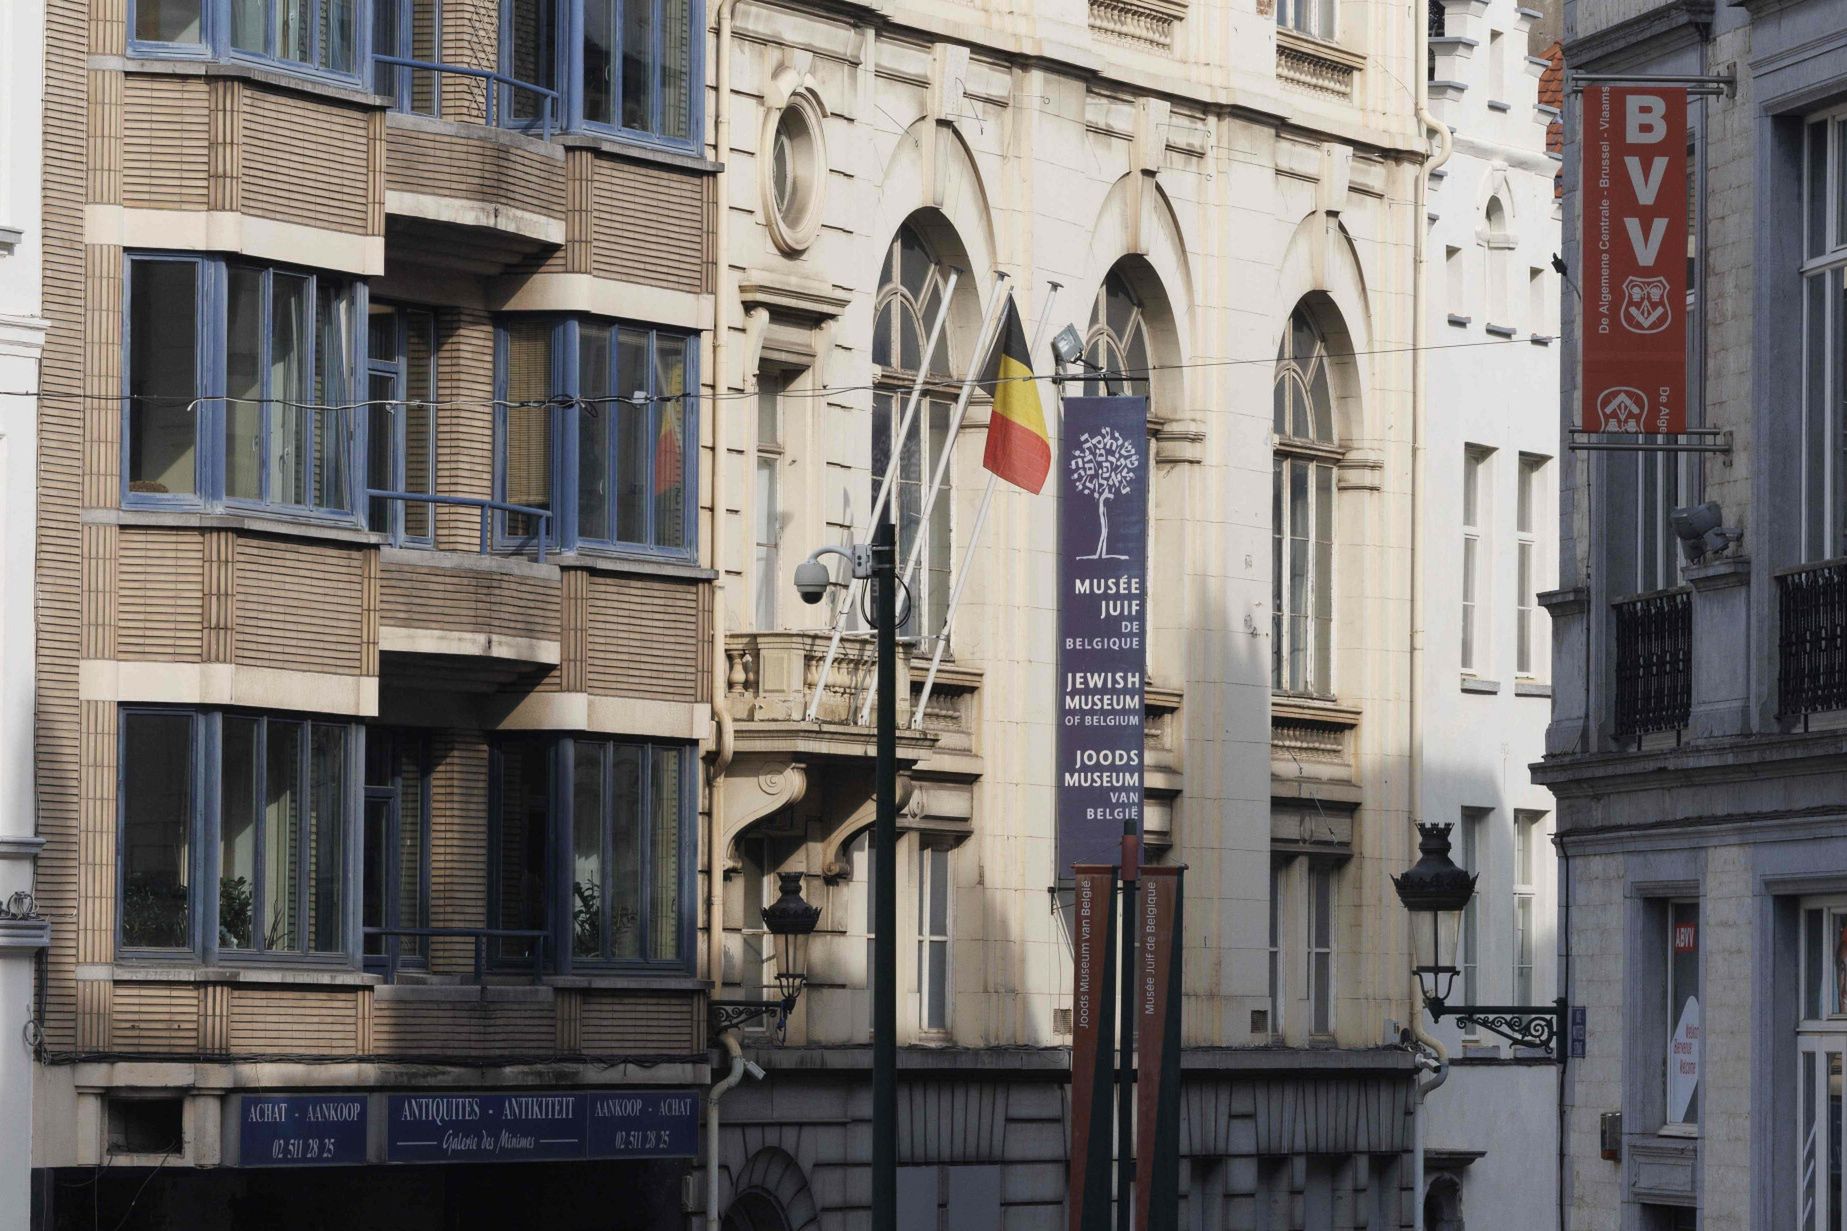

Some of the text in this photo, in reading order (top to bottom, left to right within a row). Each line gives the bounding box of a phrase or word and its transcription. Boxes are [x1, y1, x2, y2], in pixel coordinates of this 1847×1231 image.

[1600, 87, 1609, 130] Vlaams
[1600, 142, 1609, 187] Brussel
[1600, 199, 1609, 249] Centrale
[1600, 254, 1612, 314] Algemene
[1600, 319, 1609, 333] De
[1659, 387, 1669, 403] De
[1075, 575, 1139, 594] MUSÉE
[1101, 601, 1139, 619] JUIF
[1121, 622, 1139, 632] DE
[1066, 638, 1139, 650] BELGIQUE
[1067, 673, 1139, 690] JEWISH
[1065, 695, 1139, 709] MUSEUM
[1065, 716, 1139, 726] OF BELGIUM
[1076, 750, 1139, 767] JOODS
[1065, 772, 1139, 787] MUSEUM
[1110, 792, 1139, 803] VAN
[1087, 805, 1138, 819] BELGIË
[1676, 928, 1694, 947] ABVV
[1079, 880, 1091, 1028] Joods Museum van België
[1145, 882, 1157, 1015] Musée Juif de Belgique
[249, 1103, 287, 1122] ACHAT
[306, 1103, 360, 1122] AANKOOP
[402, 1099, 479, 1126] ANTIQUITES
[502, 1097, 575, 1120] ANTIKITEIT
[595, 1100, 643, 1118] AANKOOP
[659, 1099, 691, 1116] ACHAT
[273, 1138, 335, 1159] 02 511 28 25
[443, 1129, 535, 1155] Galerie des Minimes
[615, 1130, 669, 1149] 02 511 28 25
